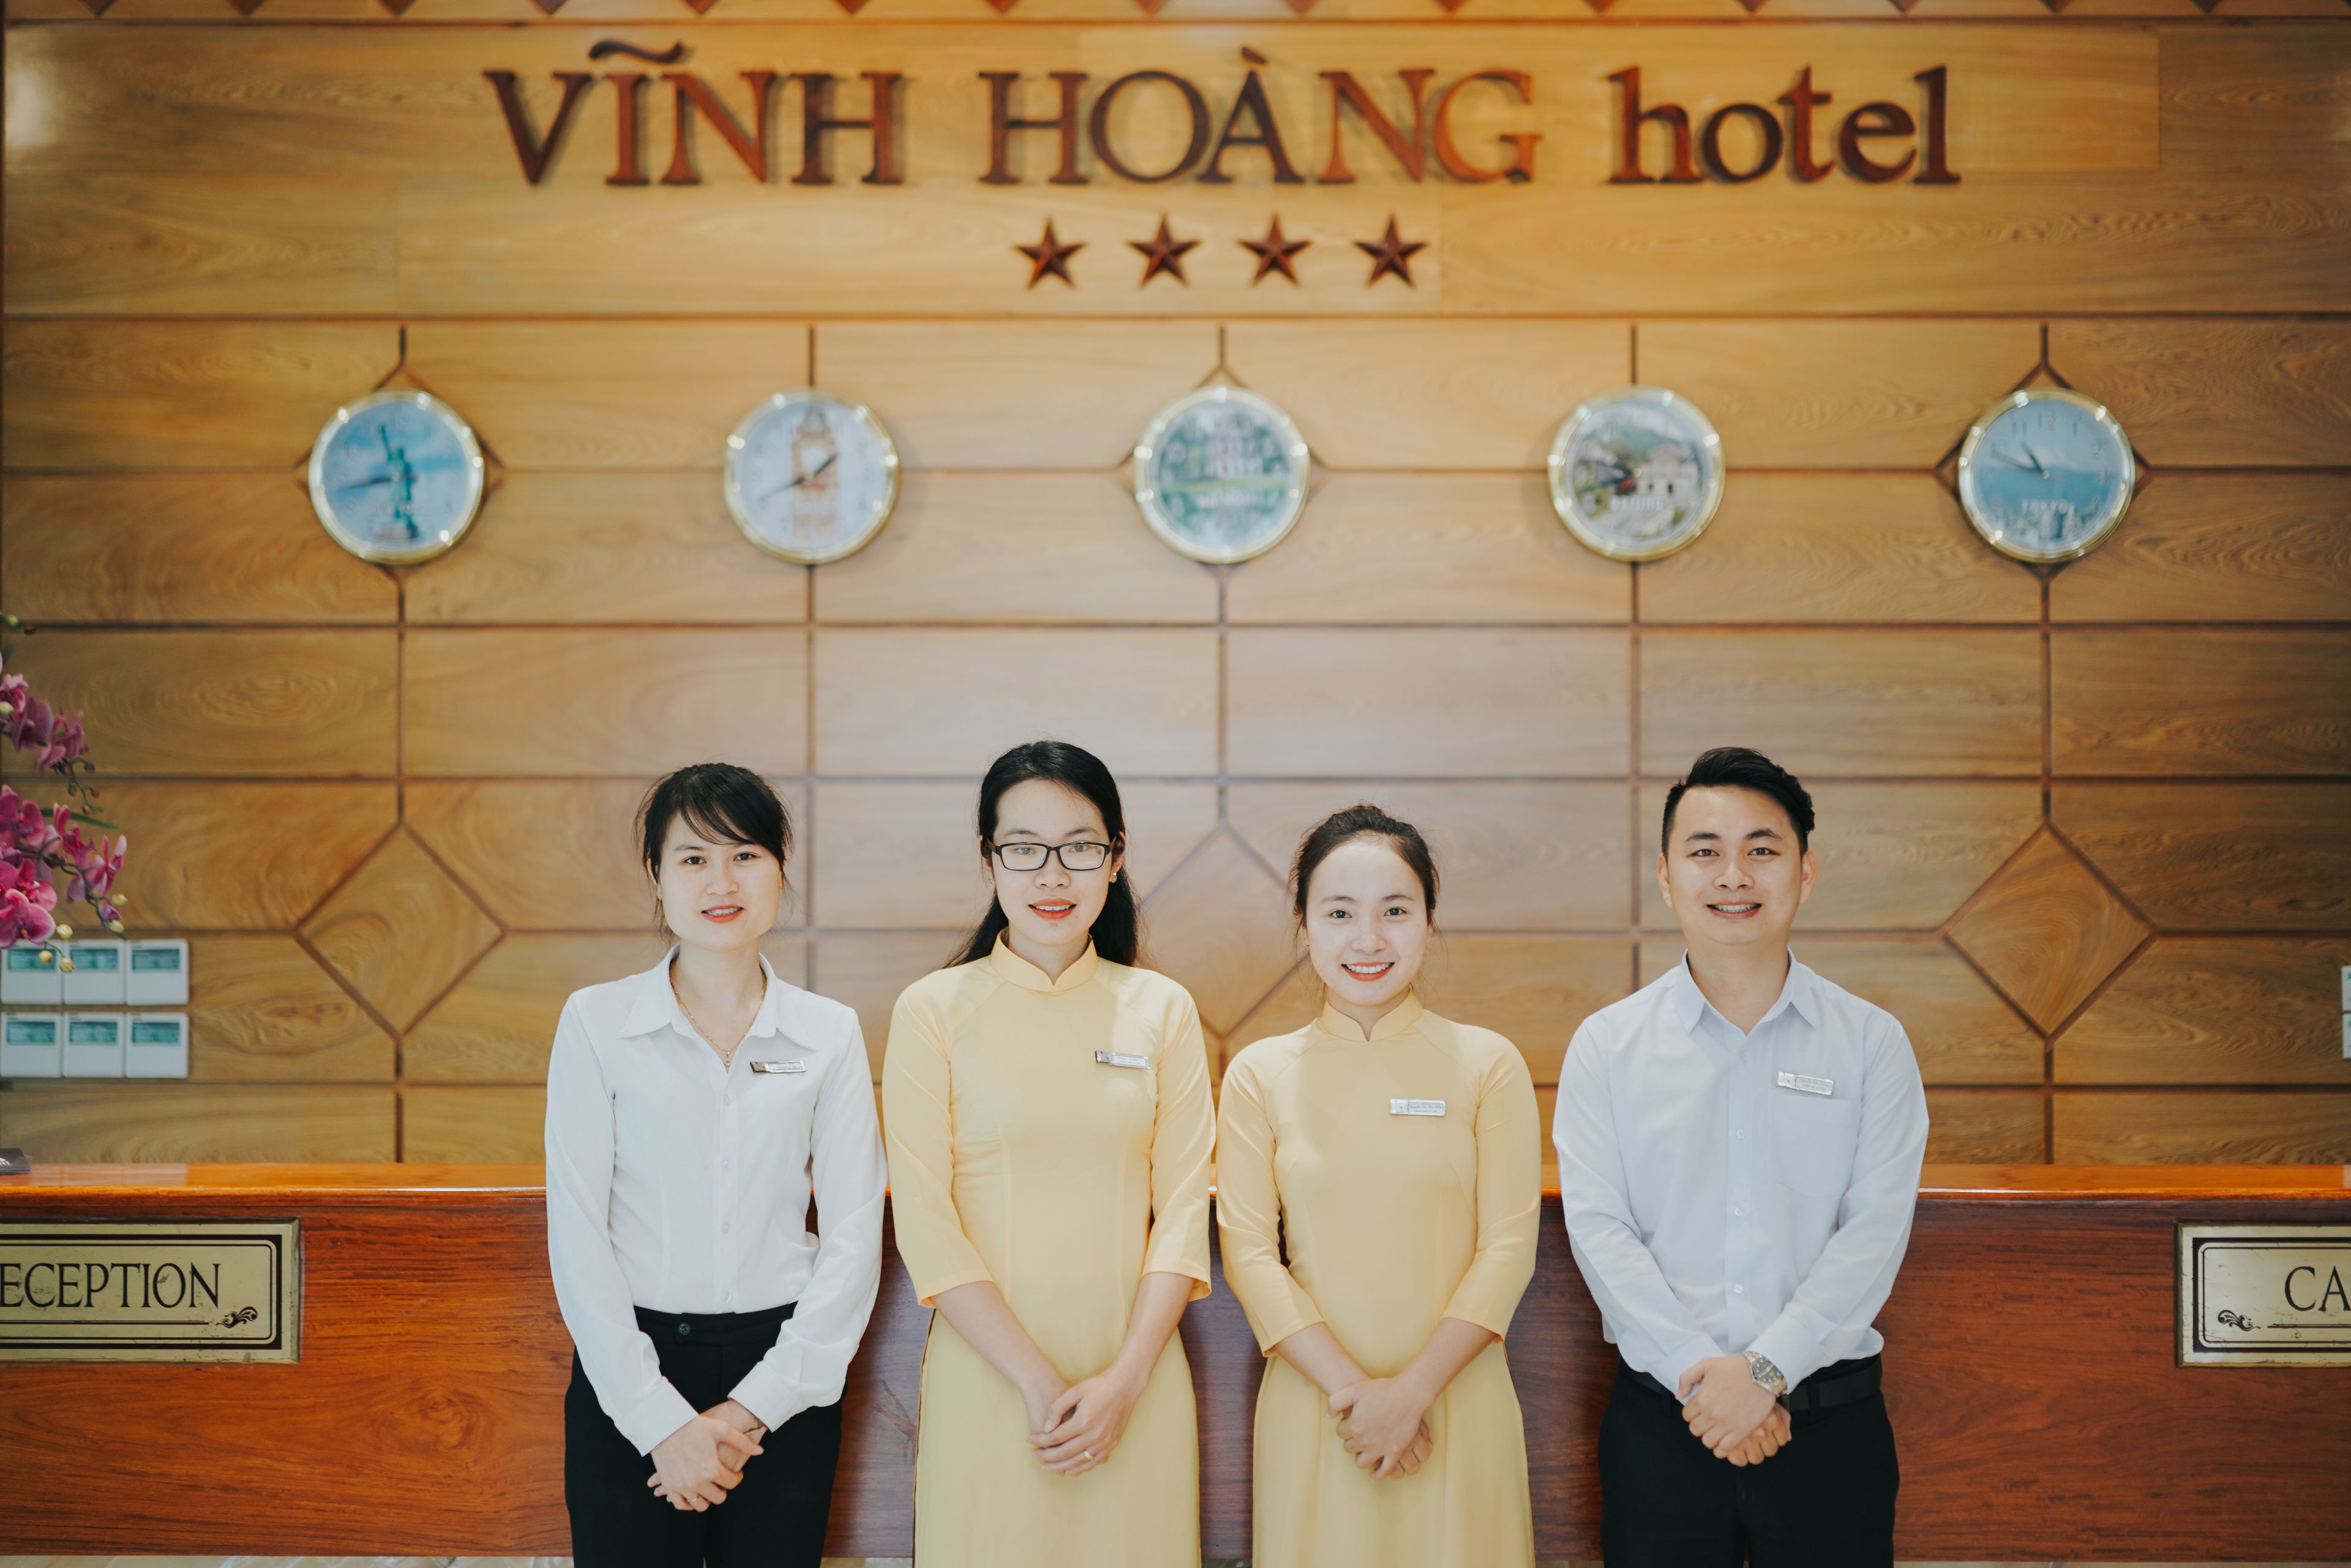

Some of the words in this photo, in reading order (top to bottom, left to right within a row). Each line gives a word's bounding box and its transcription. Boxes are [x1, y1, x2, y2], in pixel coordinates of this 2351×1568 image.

[482, 39, 905, 185] VĨNH
[977, 46, 1543, 185] HOÀNG
[1605, 64, 1962, 184] hotel
[0, 1262, 221, 1309] ECEPTION
[2284, 1266, 2351, 1312] CA
